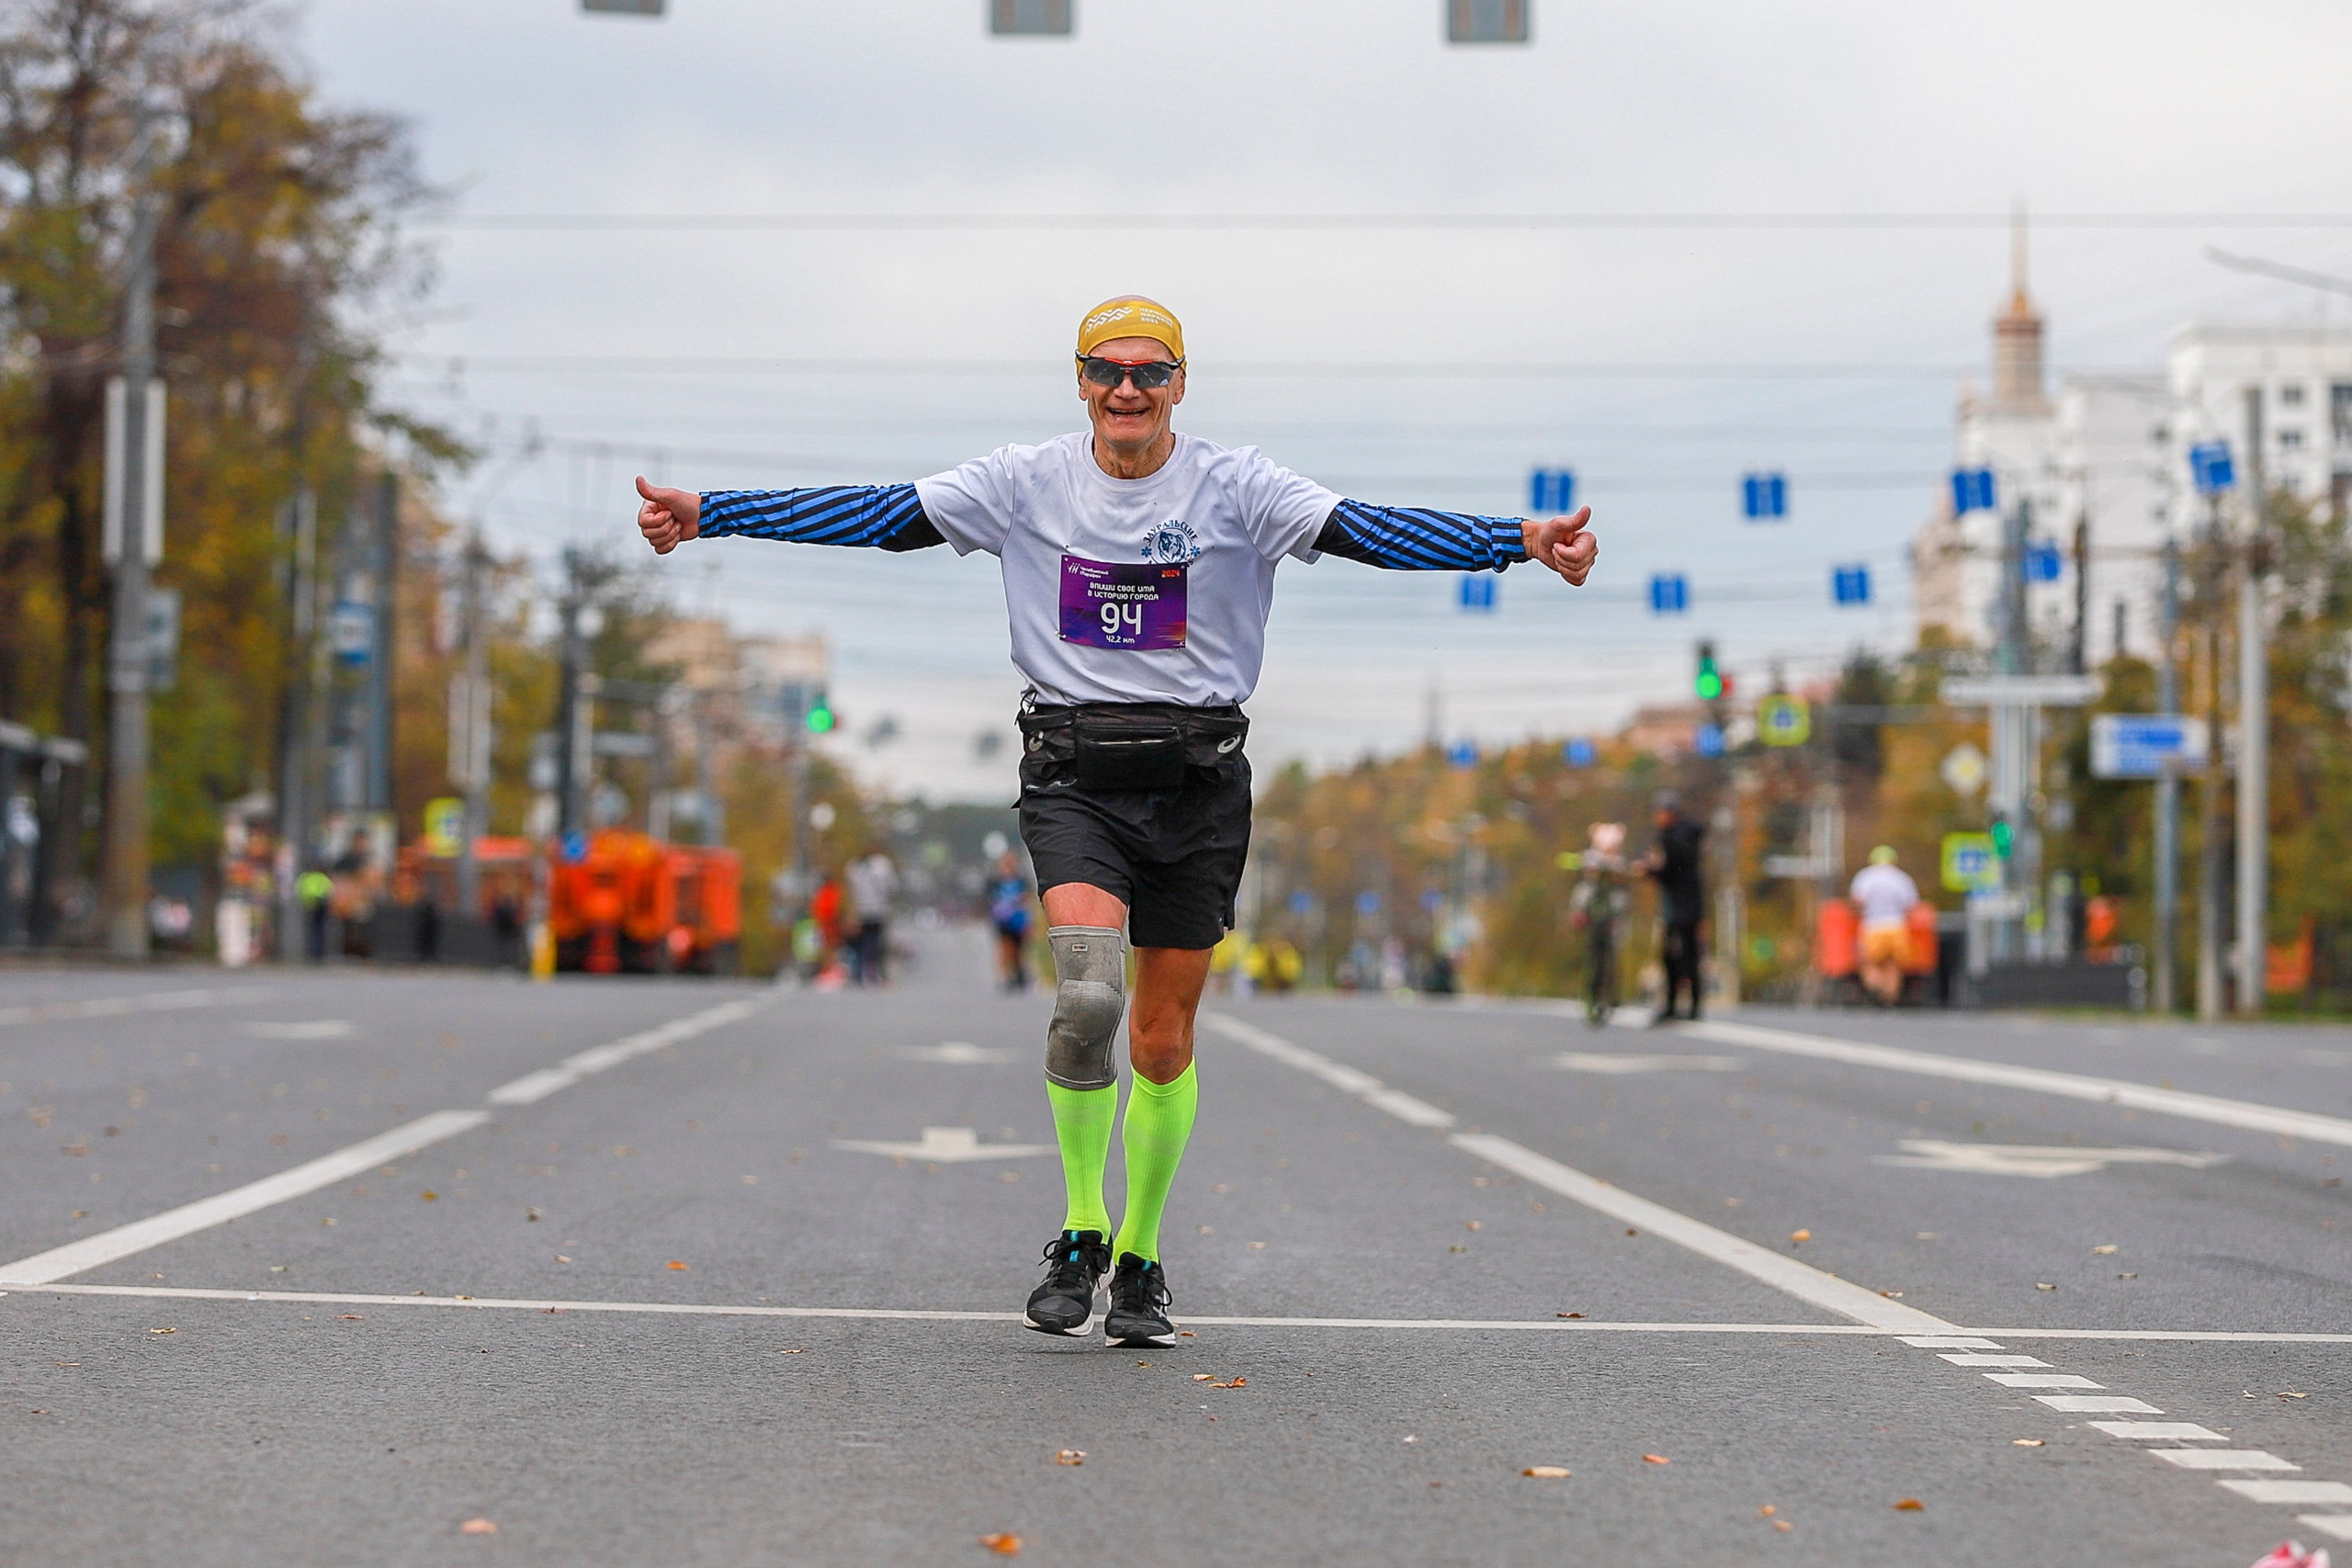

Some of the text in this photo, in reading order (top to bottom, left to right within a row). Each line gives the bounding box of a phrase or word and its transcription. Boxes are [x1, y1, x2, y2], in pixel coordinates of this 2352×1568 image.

[1161, 570, 1180, 579] 2024
[1090, 582, 1115, 591] ВПИШИ
[1117, 584, 1136, 592] СВОЕ
[1094, 592, 1128, 600] ИСТОРИЮ
[1101, 602, 1142, 635] 94
